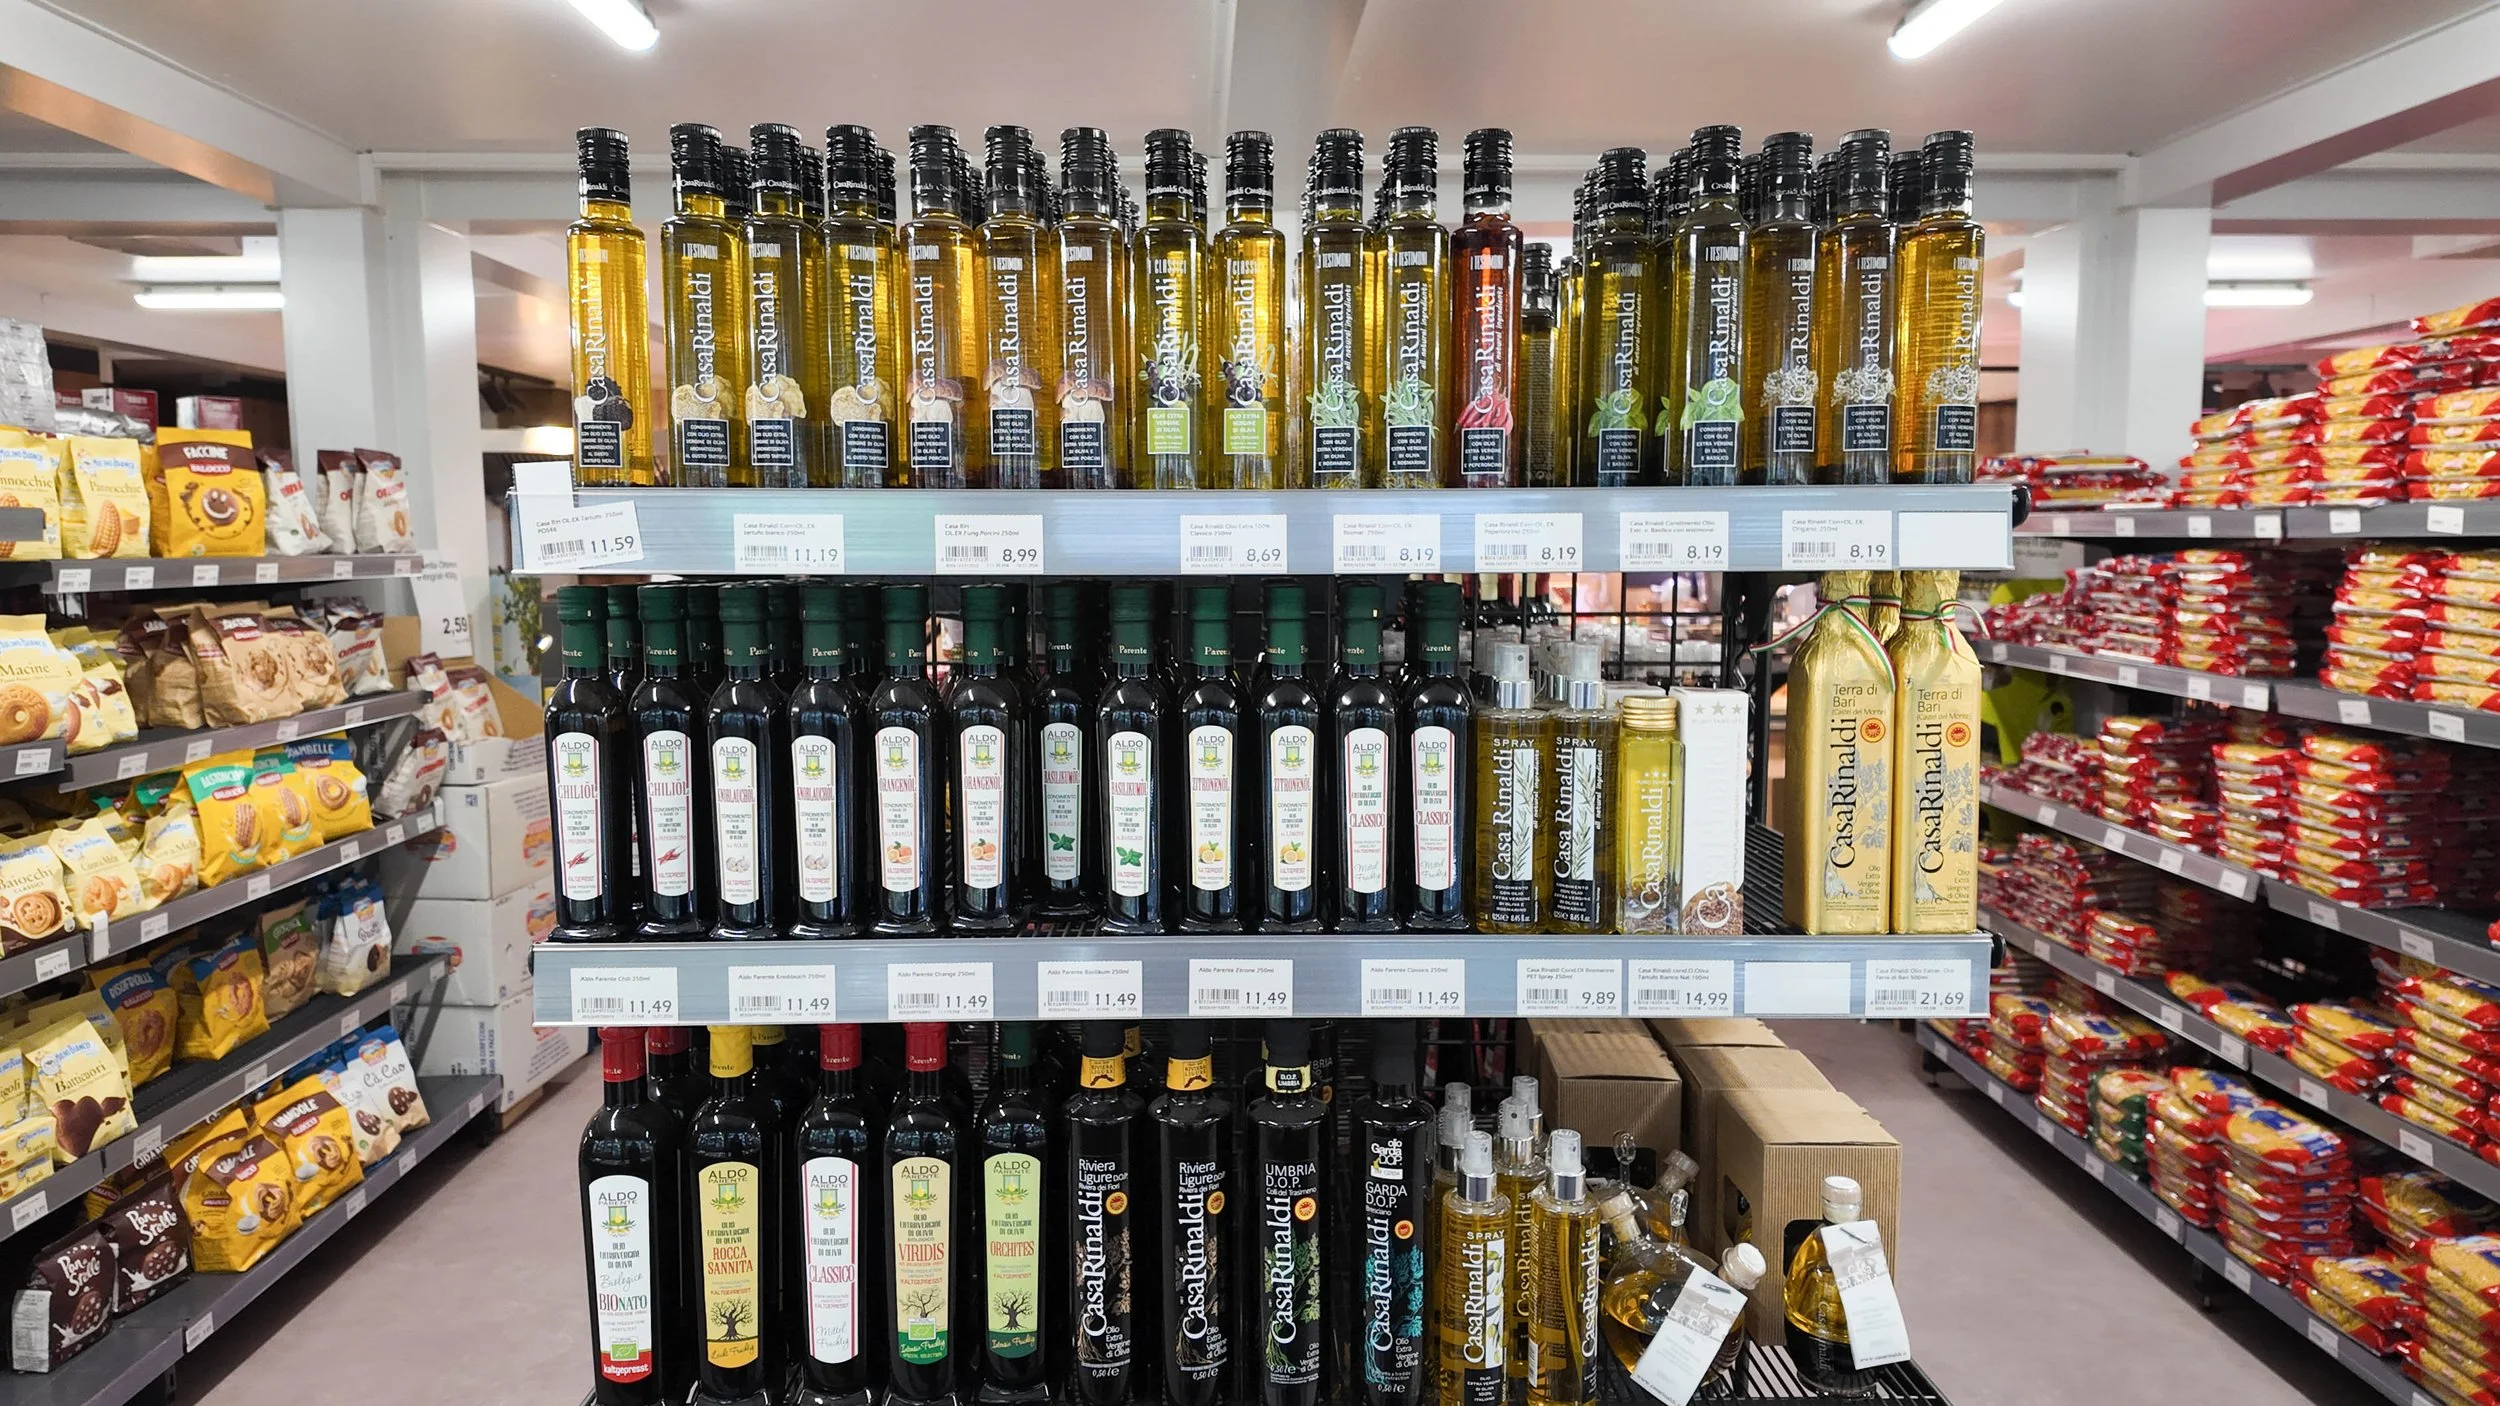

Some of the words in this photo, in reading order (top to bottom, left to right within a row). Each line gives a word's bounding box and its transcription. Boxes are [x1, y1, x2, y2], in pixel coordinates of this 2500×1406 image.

[689, 271, 718, 404] CasaRinaldi
[753, 271, 782, 404] CasaRinaldi
[852, 274, 880, 406] CasaRinaldi
[911, 275, 937, 405] CasaRinaldi
[998, 272, 1023, 405] CasaRinaldi
[1063, 276, 1089, 406] CasaRinaldi
[1155, 276, 1180, 407] CasaRinaldi
[1706, 276, 1731, 406] CasaRinaldi
[1788, 272, 1812, 404] CasaRinaldi
[1859, 272, 1882, 404] CasaRinaldi
[1324, 282, 1345, 411] CasaRinaldi
[1399, 281, 1422, 412] CasaRinaldi
[1473, 283, 1496, 415] CasaRinaldi
[1612, 290, 1637, 415] CasaRinaldi
[591, 535, 635, 555] 11,59
[1849, 544, 1886, 560] 8,19
[795, 548, 839, 564] 11,19
[1002, 548, 1038, 565] 8,99
[1246, 548, 1281, 564] 8,69
[1399, 547, 1435, 563] 8,19
[1540, 546, 1577, 563] 8,19
[1686, 545, 1722, 561] 8,19
[444, 617, 470, 637] 2,59
[1833, 684, 1863, 696] Terra
[1866, 683, 1878, 695] di
[1917, 688, 1948, 701] Terra
[1951, 688, 1962, 700] di
[1833, 695, 1856, 708] Bari
[1917, 700, 1941, 713] Bari
[882, 735, 911, 744] ALDO
[969, 733, 998, 742] ALDO
[1047, 730, 1076, 740] ALDO
[1196, 735, 1225, 744] ALDO
[1278, 735, 1307, 744] ALDO
[1493, 738, 1535, 747] SPRAY
[1555, 736, 1597, 747] SPRAY
[560, 741, 590, 750] ALDO
[652, 739, 683, 748] ALDO
[721, 745, 749, 754] ALDO
[799, 744, 828, 753] ALDO
[1114, 739, 1143, 748] ALDO
[1352, 743, 1381, 752] ALDO
[1417, 741, 1446, 751] ALDO
[1830, 715, 1856, 869] CasaRinaldi
[1918, 719, 1942, 874] CasaRinaldi
[1349, 812, 1385, 828] CLASSICO
[1415, 810, 1452, 827] CLASSICO
[788, 998, 830, 1013] 11,49
[946, 994, 988, 1010] 11,49
[1095, 992, 1137, 1008] 11,49
[1245, 992, 1287, 1006] 11,49
[1418, 991, 1459, 1006] 11,49
[1581, 991, 1616, 1006] 9,89
[1685, 992, 1728, 1007] 14,99
[1920, 991, 1965, 1007] 21,69
[630, 1000, 673, 1015] 11,49
[54, 1062, 107, 1094] Batticuori
[1371, 1143, 1402, 1157] Garda
[902, 1165, 939, 1175] ALDO
[994, 1161, 1031, 1171] ALDO
[1077, 1159, 1114, 1172] Riviera
[1177, 1160, 1214, 1174] Riviera
[1265, 1162, 1316, 1176] UMBRIA
[709, 1168, 748, 1179] ALDO
[812, 1174, 849, 1184] ALDO
[1077, 1172, 1112, 1187] Ligure
[1177, 1173, 1212, 1188] Ligure
[1265, 1175, 1301, 1188] D.O.P.
[1365, 1181, 1408, 1197] GARDA
[599, 1191, 638, 1201] ALDO
[1365, 1195, 1397, 1209] D.O.P.
[1466, 1229, 1505, 1241] SPRAY
[713, 1247, 748, 1260] ROCCA
[899, 1243, 945, 1262] VIRIDIS
[990, 1240, 1035, 1257] ORCHITES
[708, 1261, 754, 1275] SANNITA
[1077, 1191, 1106, 1339] CasaRinaldi
[1177, 1193, 1206, 1341] CasaRinaldi
[1267, 1197, 1297, 1344] CasaRinaldi
[810, 1264, 856, 1284] CLASSICO
[1370, 1217, 1391, 1352] CasaRinaldi
[600, 1292, 649, 1312] BIONATO
[1463, 1242, 1484, 1363] CasaRinaldi
[1104, 1326, 1119, 1334] Olio
[1105, 1334, 1121, 1343] Extra
[1395, 1338, 1409, 1346] Olio
[1395, 1346, 1412, 1354] Extra
[603, 1363, 650, 1378] kaltgepresst
